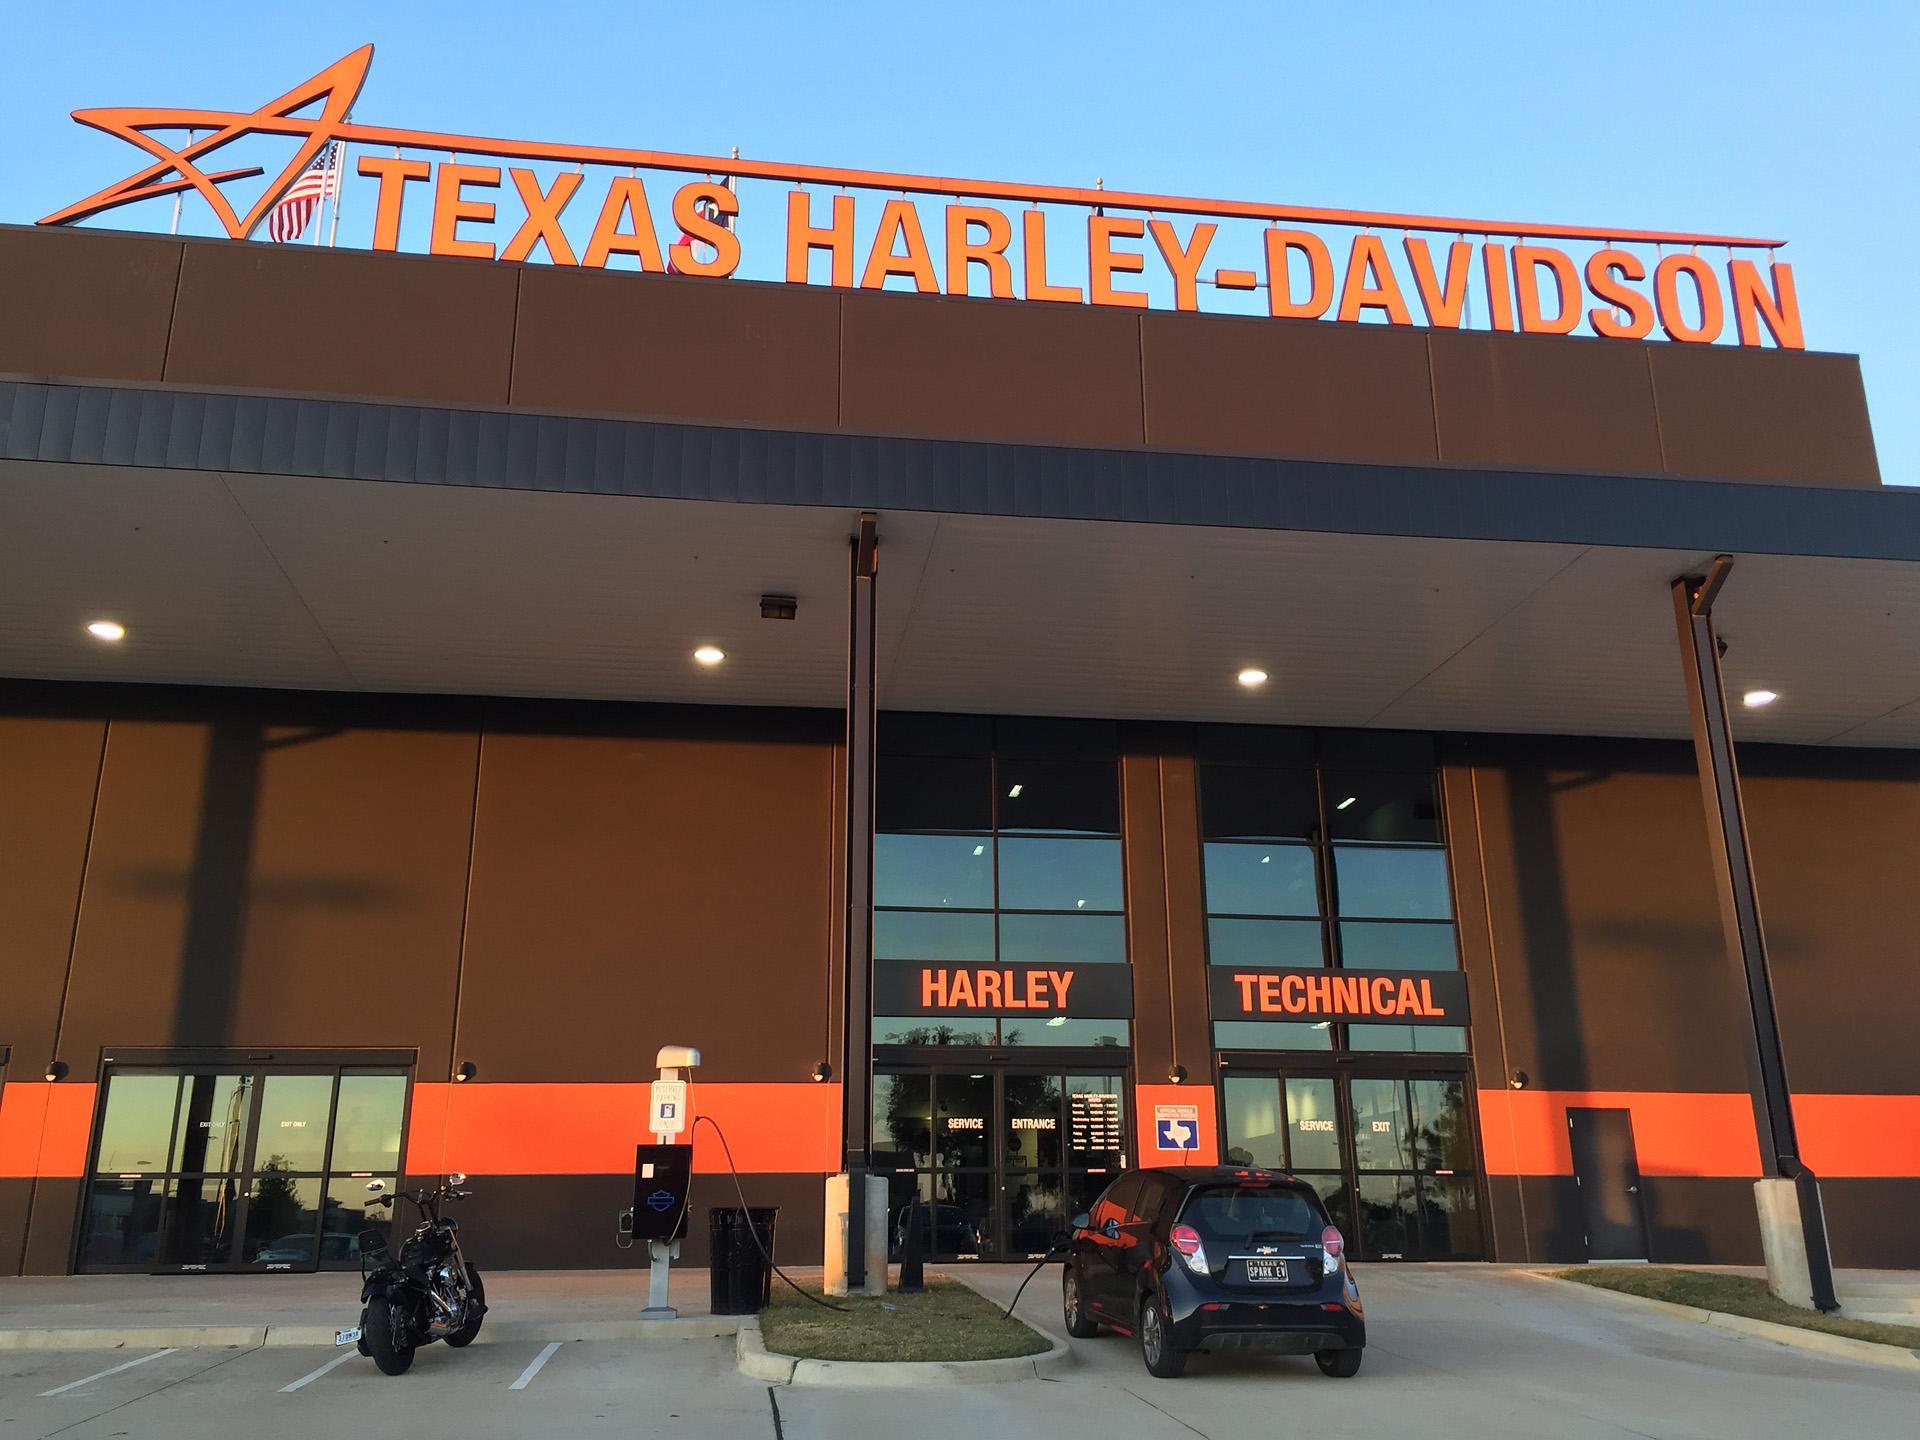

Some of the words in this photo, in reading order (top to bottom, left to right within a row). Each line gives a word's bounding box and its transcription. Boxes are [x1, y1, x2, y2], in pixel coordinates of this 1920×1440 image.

[357, 155, 741, 278] TEXAS
[785, 190, 1805, 350] HARLEY-DAVIDSON
[921, 969, 1074, 1009] HARLEY
[1234, 974, 1445, 1017] TECHNICAL
[948, 1118, 983, 1129] SERVICE
[1011, 1118, 1056, 1129] ENTRANCE
[1300, 1120, 1334, 1131] SERVICE
[1372, 1121, 1390, 1132] EXIT
[1249, 1266, 1272, 1277] SPARK
[1276, 1266, 1285, 1277] EV
